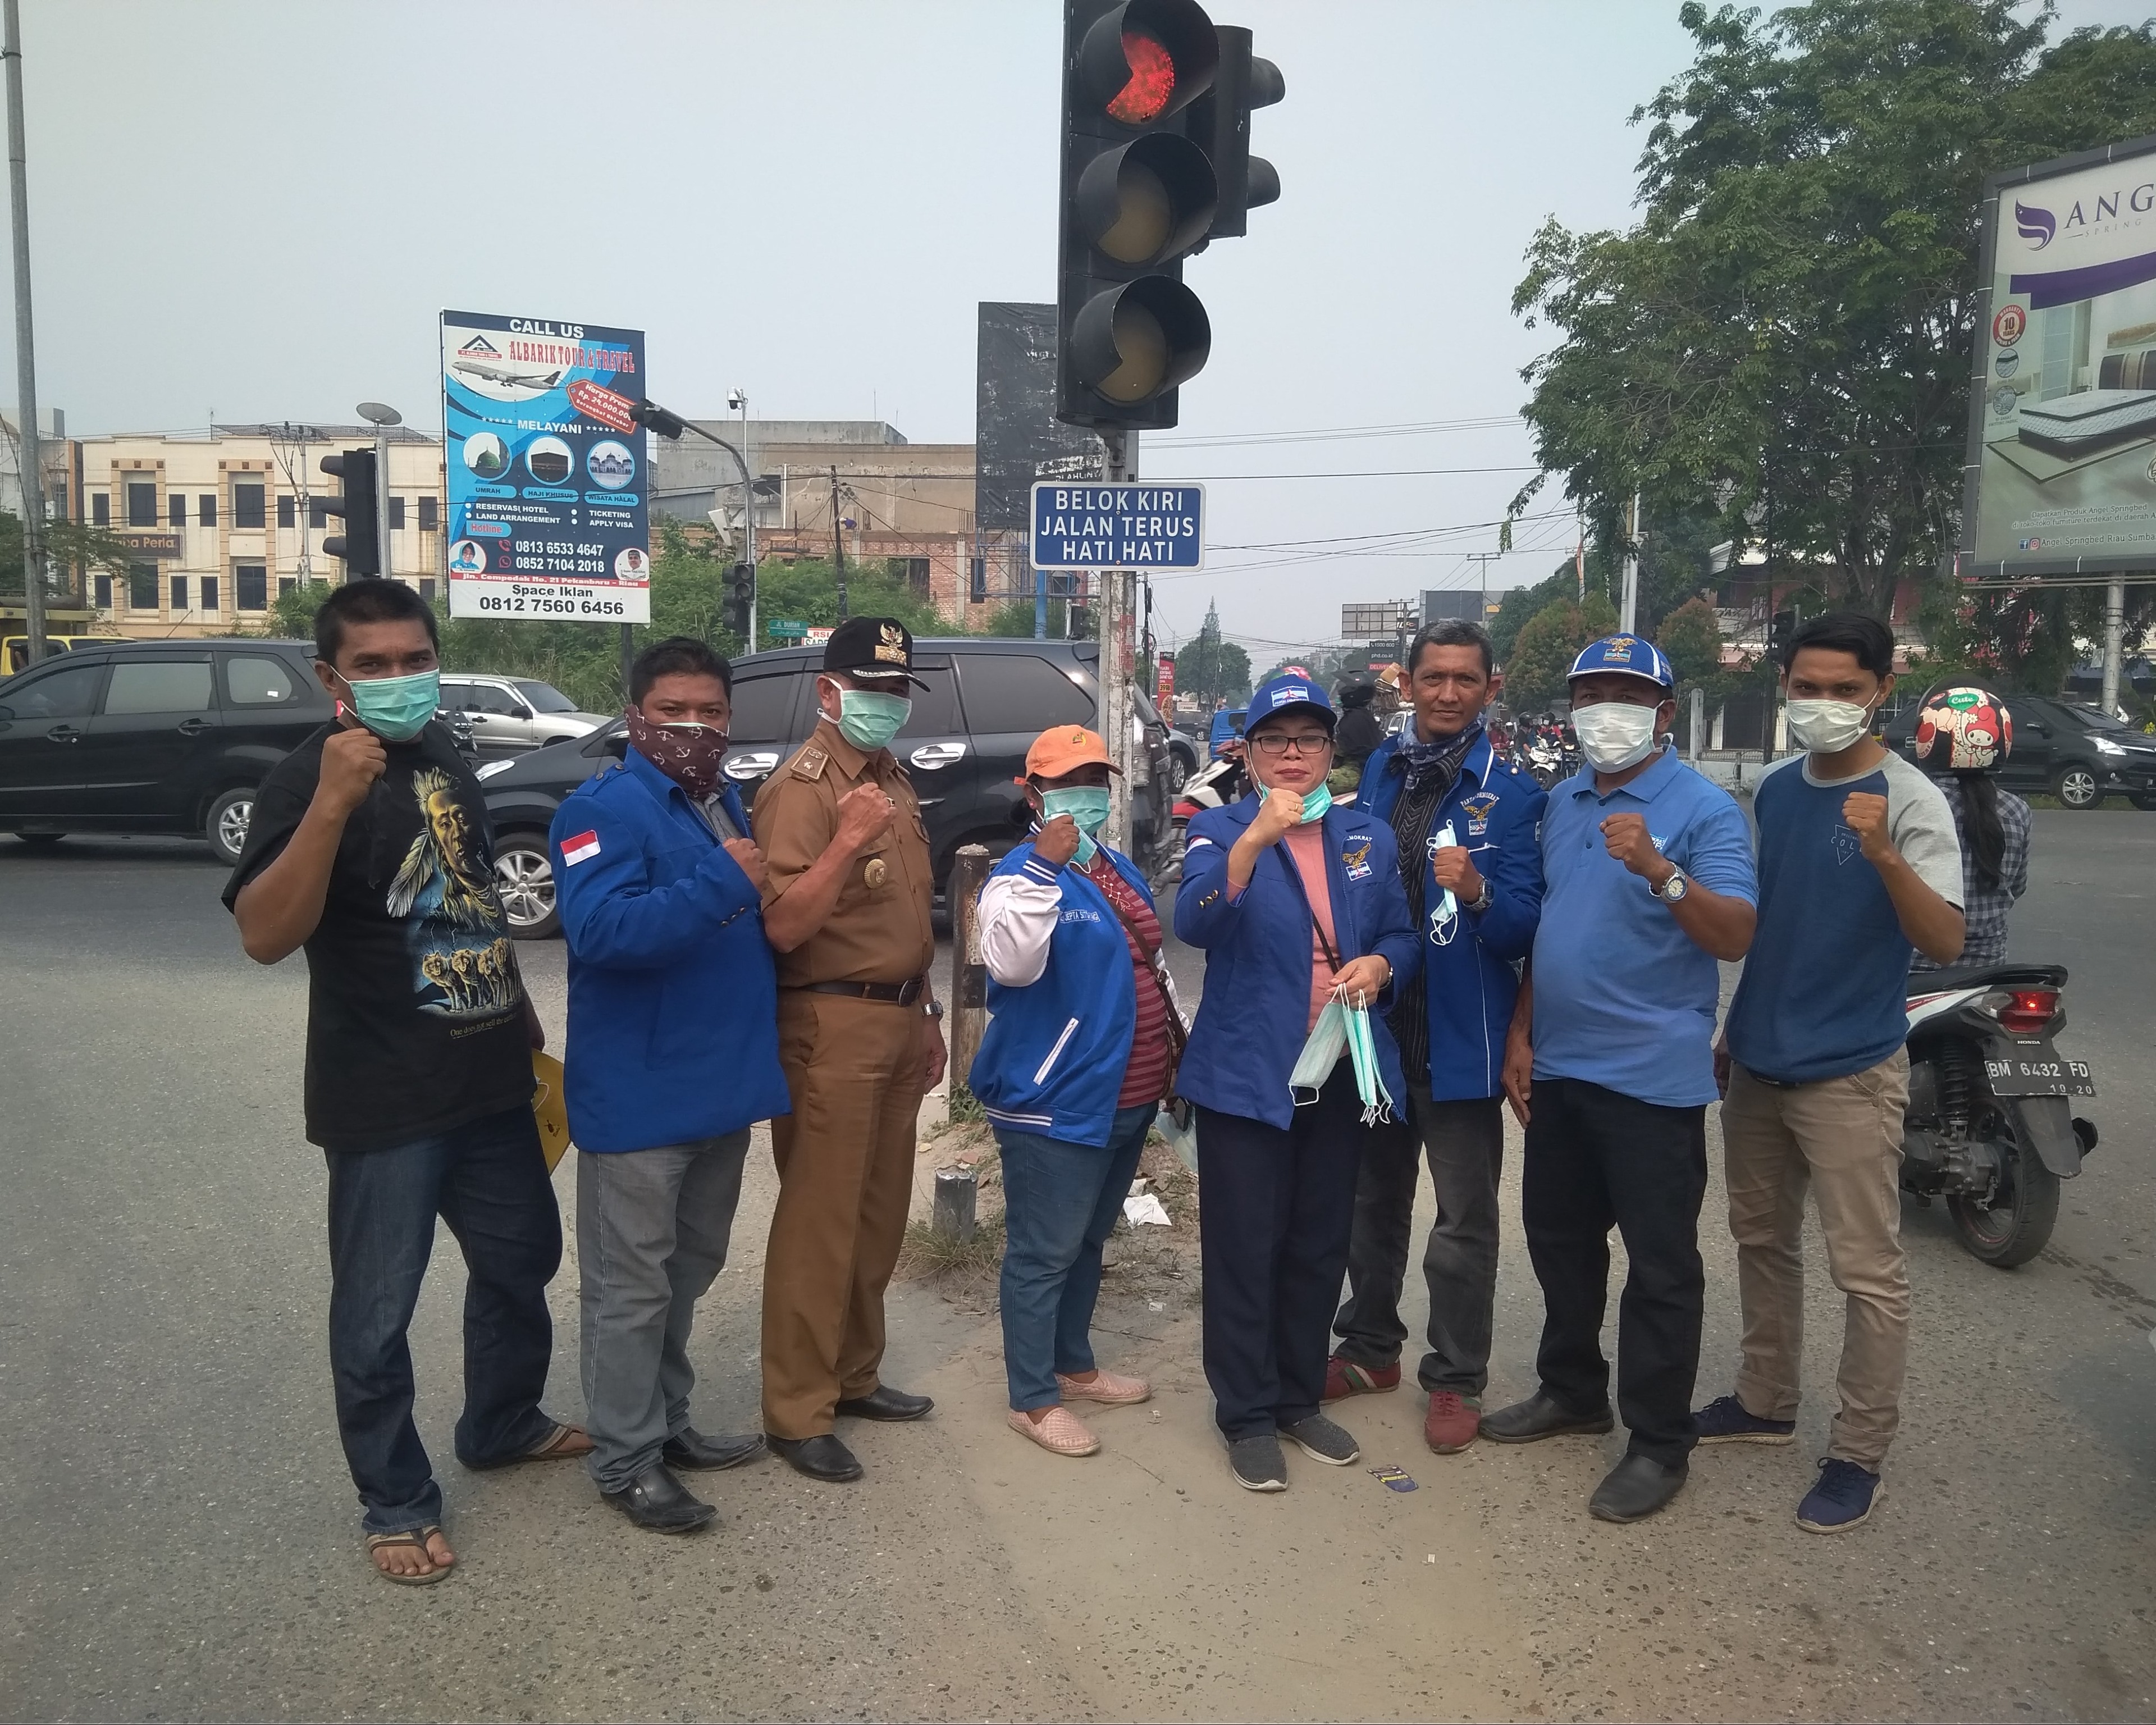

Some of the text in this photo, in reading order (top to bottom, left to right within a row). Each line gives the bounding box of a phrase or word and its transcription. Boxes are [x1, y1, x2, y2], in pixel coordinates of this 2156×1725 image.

[2085, 218, 2141, 238] SPRING
[510, 319, 584, 339] CALL US
[2004, 317, 2015, 330] 10
[510, 340, 635, 373] ALBARIK TOUR & TRAVEL
[578, 390, 590, 400] Rp.
[586, 384, 630, 410] Harga Prom
[576, 399, 606, 416] Berangkat
[518, 419, 582, 434] MELAYANI
[476, 503, 520, 512] RESERVASI
[1056, 490, 1182, 511] BELOK KIRI
[2111, 503, 2147, 513] Springbed
[476, 513, 561, 524] LAND ARRANGEMENT
[589, 510, 631, 518] TICKETING
[471, 523, 503, 533] Hotline
[1041, 516, 1194, 537] JALAN TERUS
[143, 537, 174, 549] Perla
[515, 541, 604, 556] 0813 6533 4647
[2041, 539, 2062, 547] Angel
[2065, 535, 2104, 545] Springbed
[1063, 541, 1172, 561] HATI HATI
[515, 556, 605, 573] 0852 7104 2018
[512, 585, 593, 597] Space Iklan
[479, 597, 624, 614] 0812 7560 6456
[486, 1019, 495, 1027] sell
[1988, 1062, 2089, 1078] BM 6432 FD
